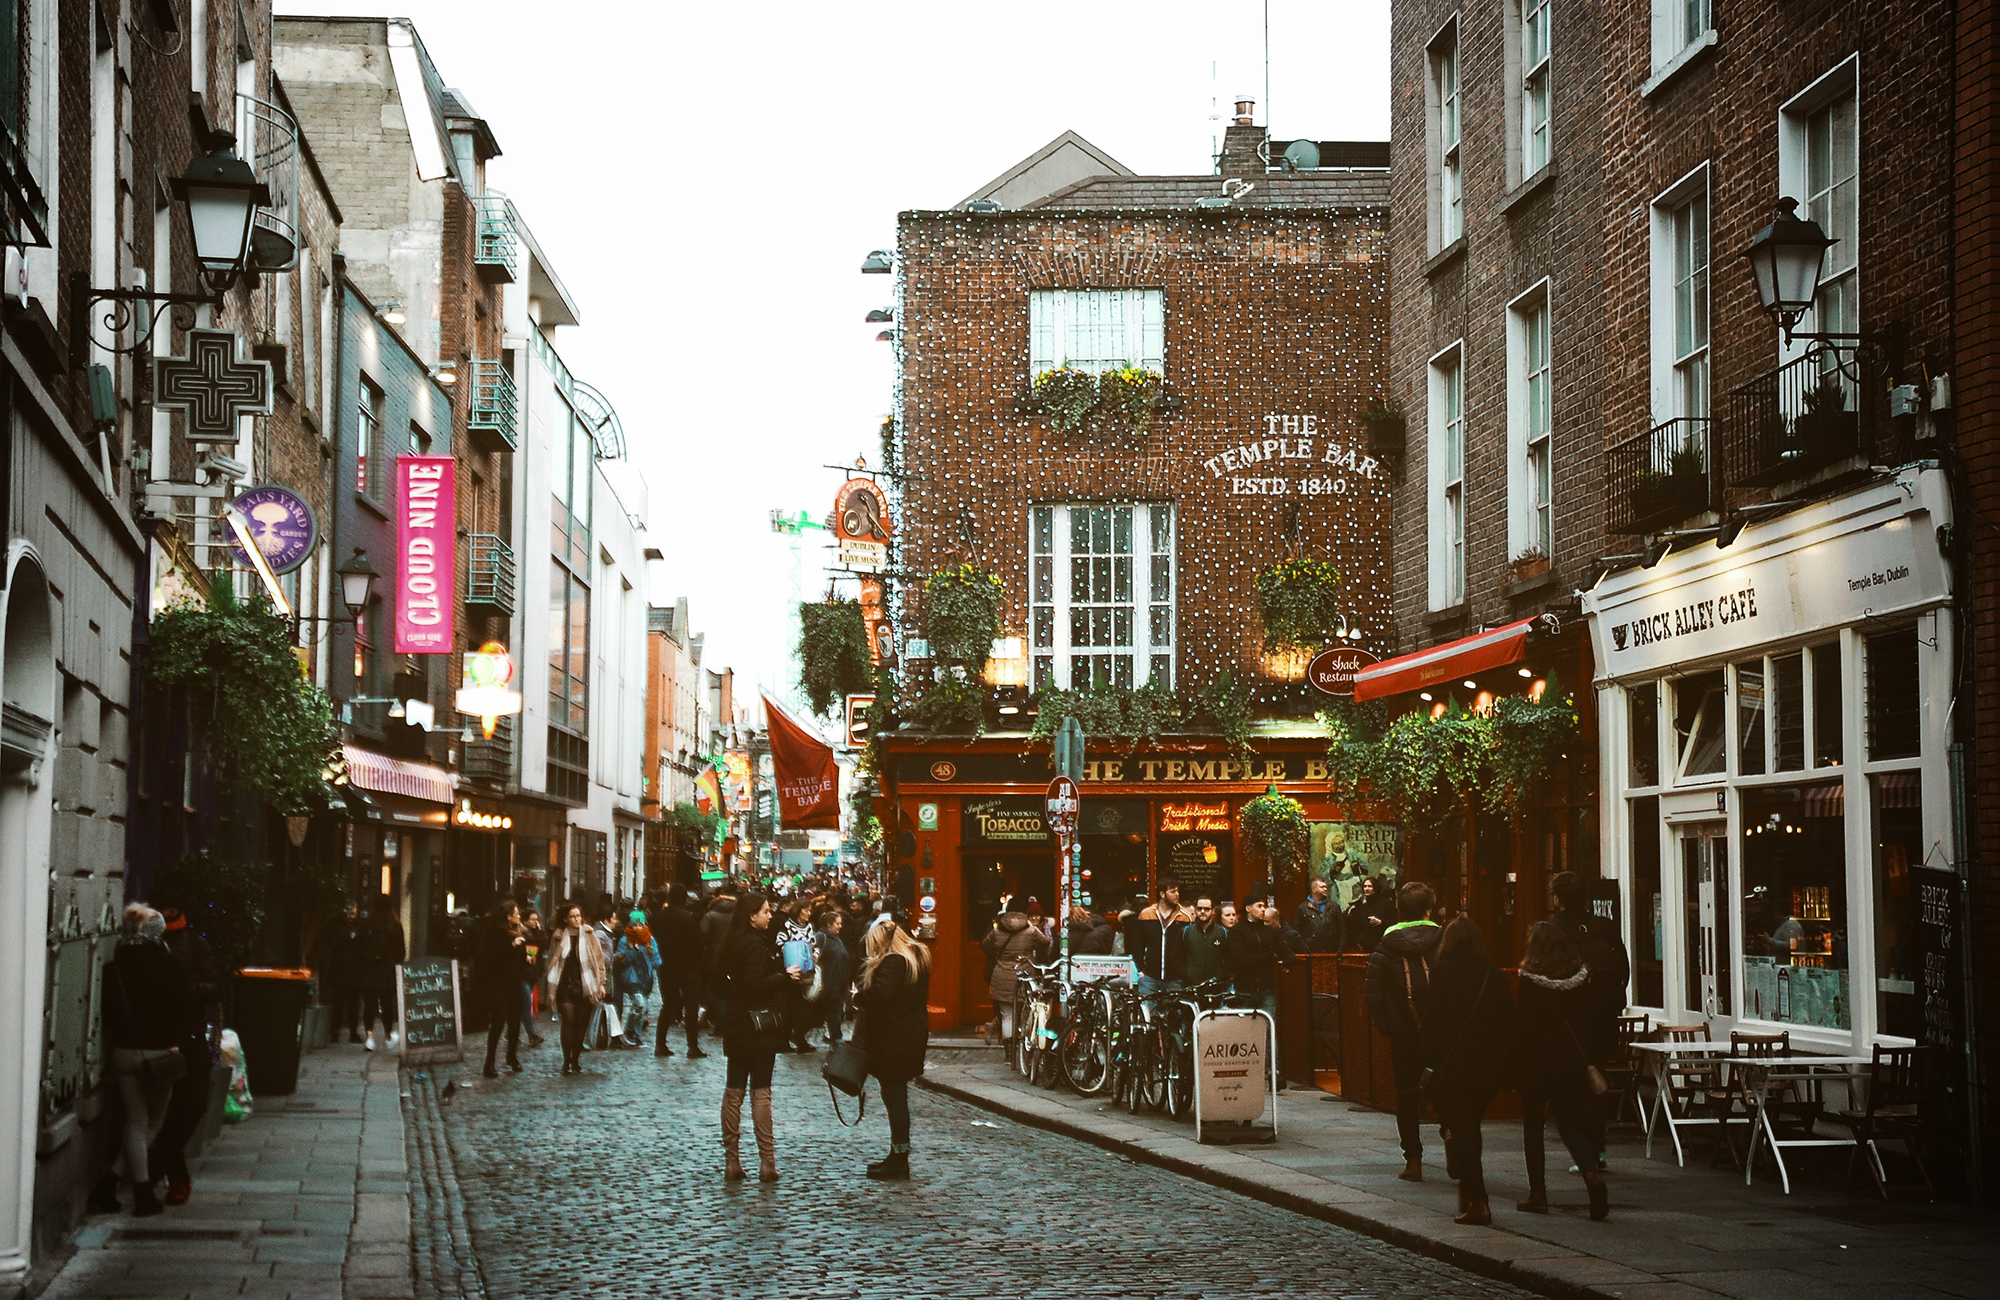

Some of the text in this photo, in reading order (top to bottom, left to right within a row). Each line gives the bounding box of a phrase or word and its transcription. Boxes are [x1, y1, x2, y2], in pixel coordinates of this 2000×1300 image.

[1265, 415, 1318, 435] THE
[1203, 439, 1377, 479] TEMPLE BAR
[1300, 478, 1346, 495] 1840
[408, 464, 444, 529] NINE
[839, 480, 888, 518] THE TEMPLE BAR
[236, 491, 307, 528] EAL'S YARD
[849, 542, 877, 551] DUBLIN
[844, 554, 881, 565] LIVE MUSIC
[407, 537, 443, 626] CLOUD
[1847, 566, 1909, 592] Temple Bar, Dublin
[1633, 579, 1758, 647] BRICK ALLEY CAFÉ
[1319, 672, 1353, 683] Restau
[935, 764, 951, 776] 48
[1082, 761, 1124, 780] HE
[1139, 760, 1286, 780] TEMPLE
[782, 780, 832, 798] TEMPLE
[797, 777, 818, 785] THE
[797, 794, 821, 807] BAR
[1162, 803, 1227, 818] Traditional
[976, 815, 1041, 836] TOBACCO
[1161, 818, 1230, 832] Irish Music
[1173, 838, 1201, 851] TEMPLE
[1364, 842, 1396, 855] BAR
[1920, 884, 1949, 907] BRICK
[1204, 1043, 1260, 1058] ARIOSA
